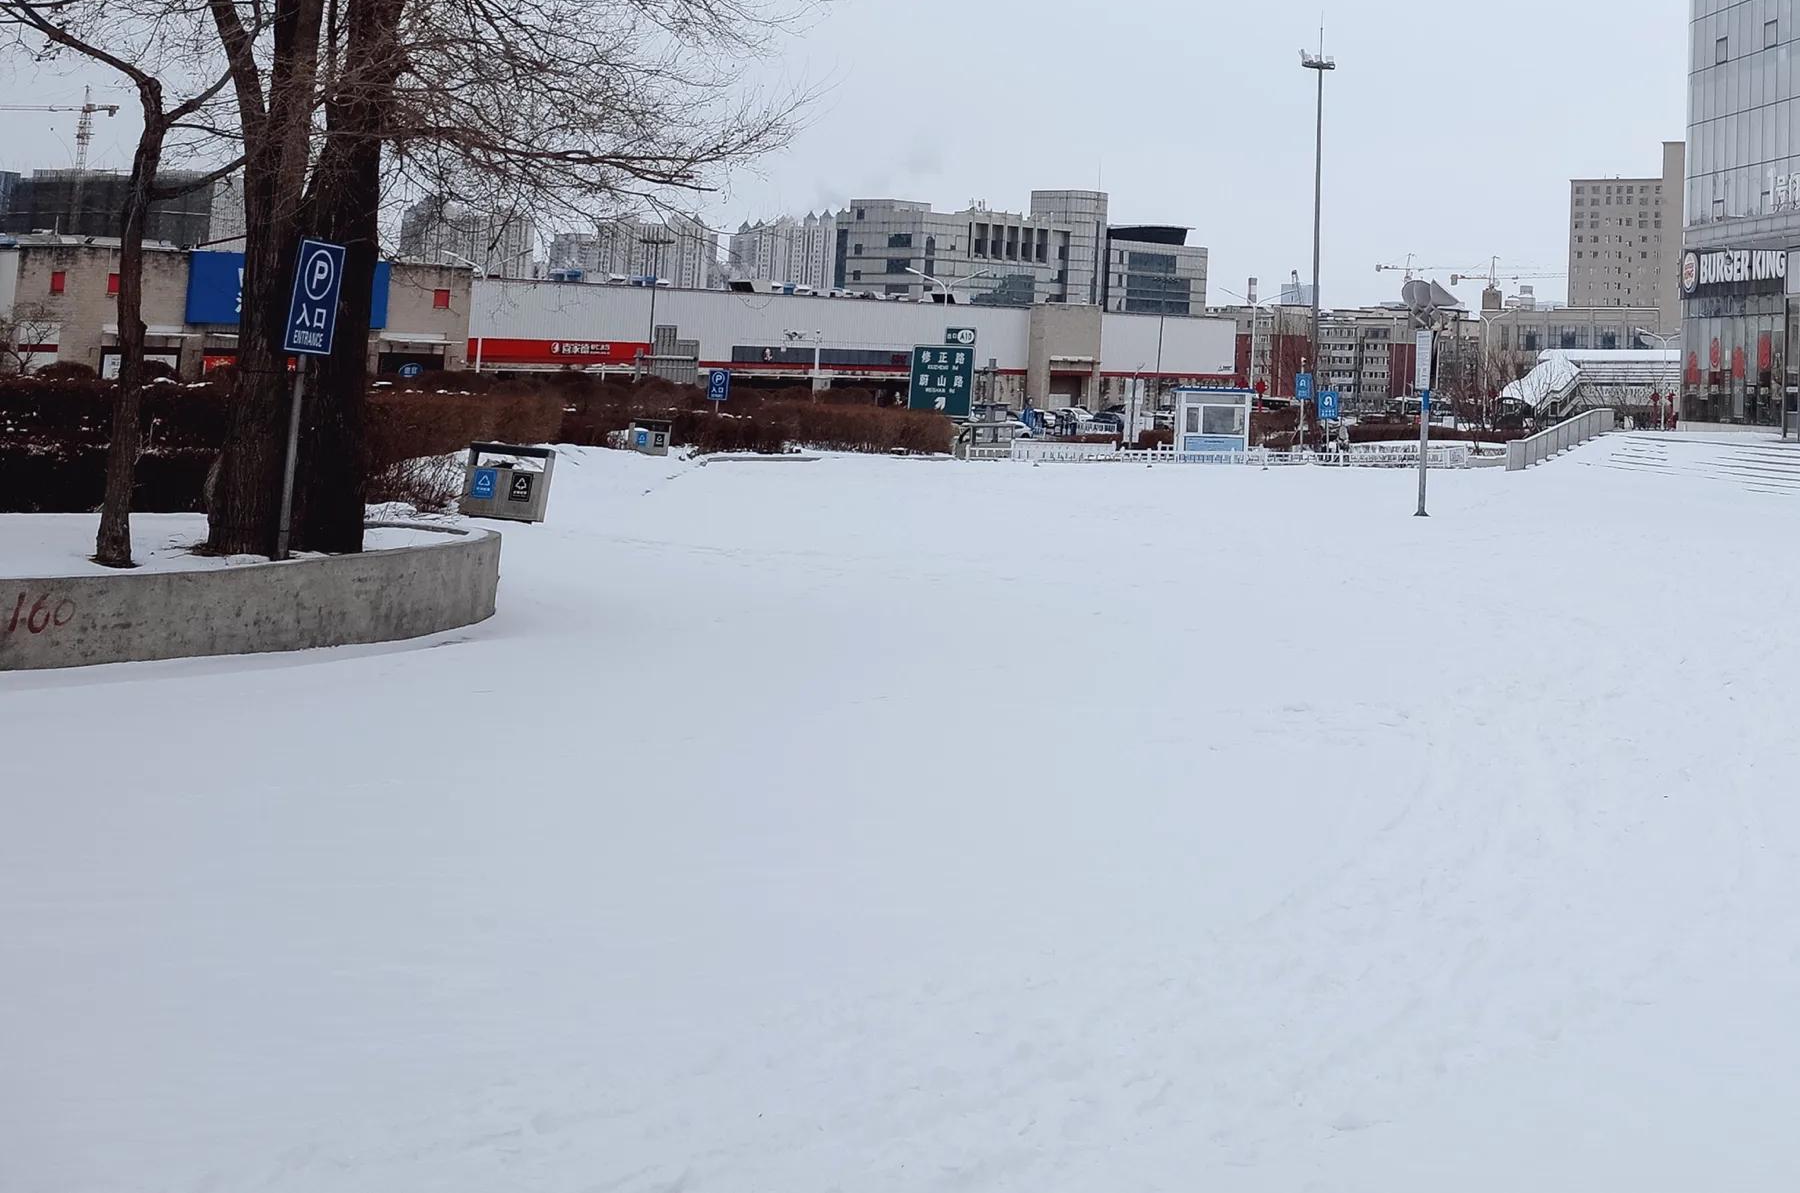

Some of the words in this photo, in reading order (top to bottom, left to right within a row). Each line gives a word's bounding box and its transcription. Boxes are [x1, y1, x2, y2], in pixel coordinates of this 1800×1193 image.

[1700, 249, 1750, 284] BURGER
[1752, 250, 1786, 281] KING
[296, 303, 327, 329] 入口
[293, 329, 324, 348] ENTRANCE
[921, 350, 965, 365] 修正路
